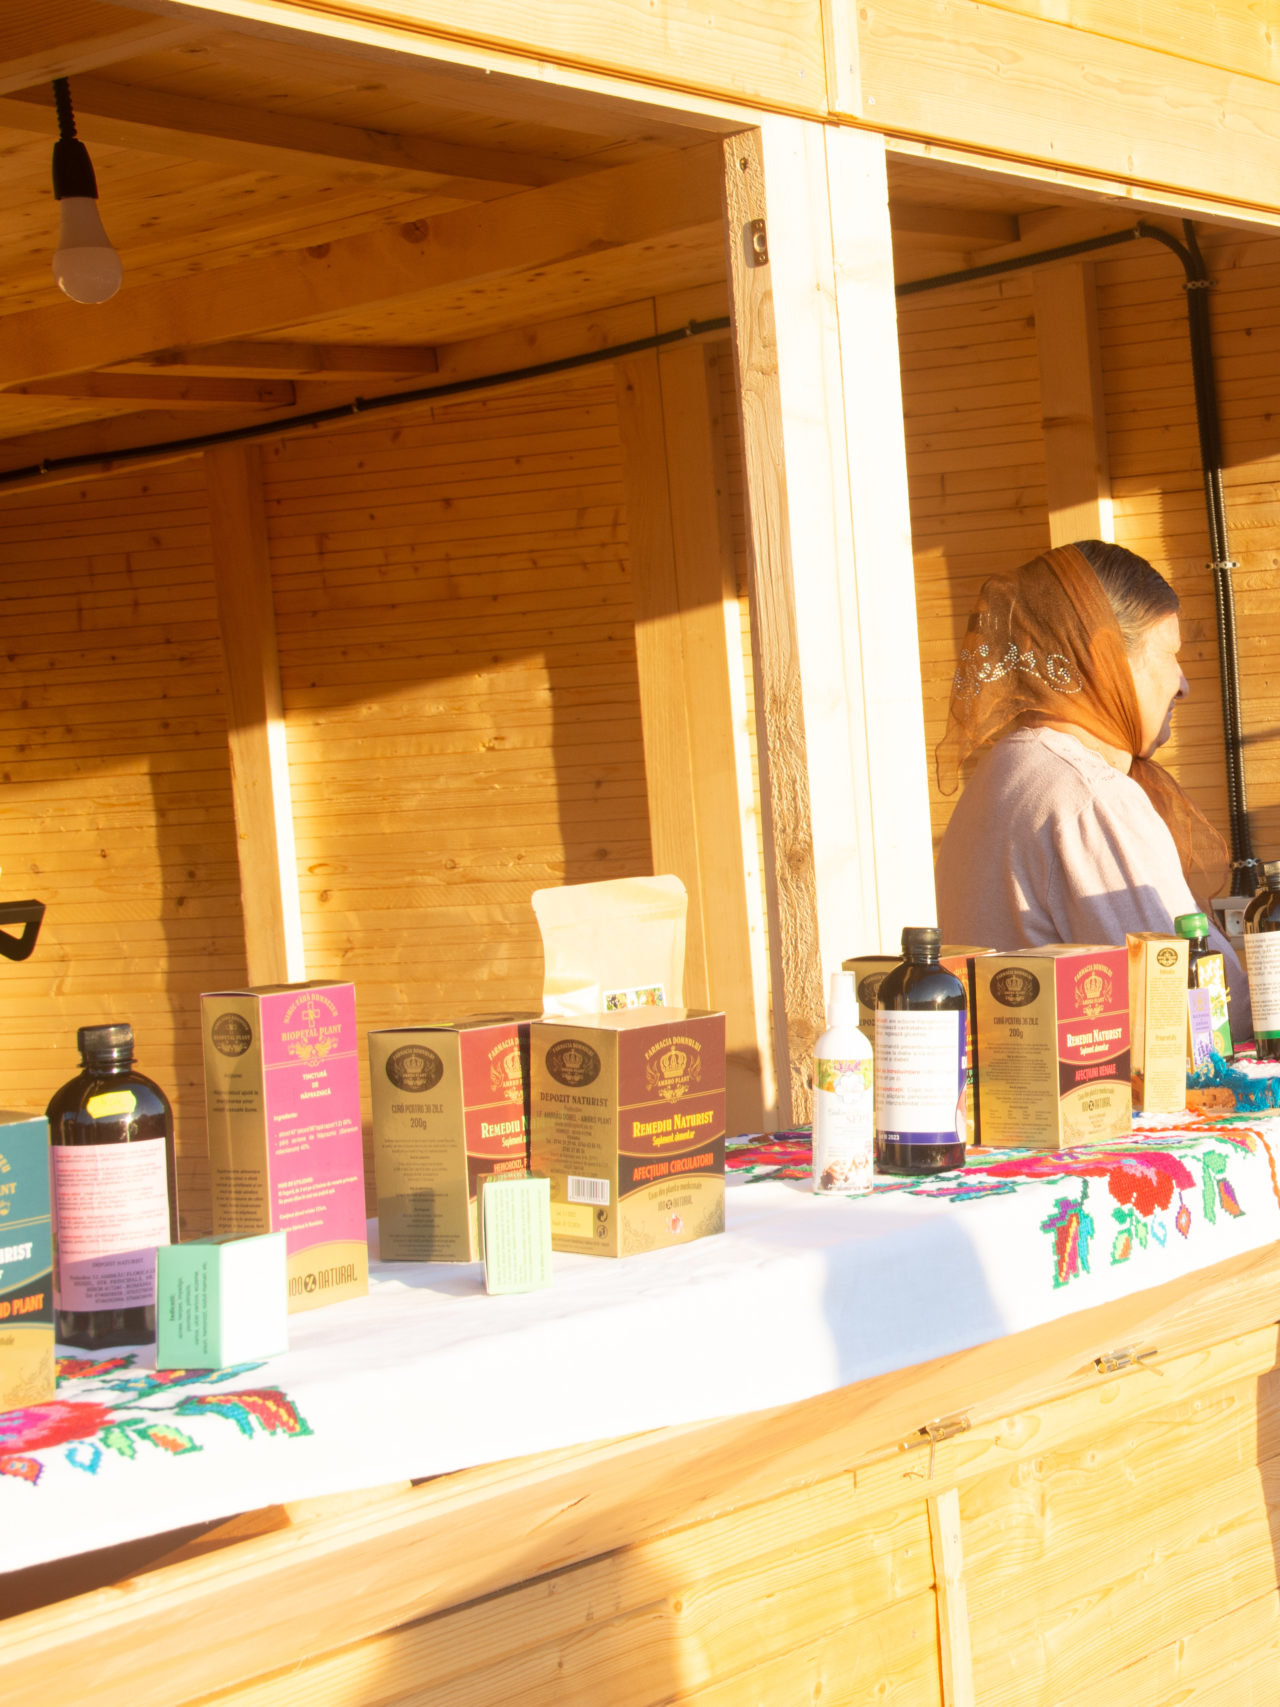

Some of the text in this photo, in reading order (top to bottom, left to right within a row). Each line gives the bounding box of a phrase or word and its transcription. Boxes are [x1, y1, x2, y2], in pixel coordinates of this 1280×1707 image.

[320, 1024, 342, 1036] PLANT
[1009, 1028, 1023, 1039] 200g
[1066, 1028, 1122, 1048] REMEDIU NATURIST
[540, 1092, 608, 1107] DEPOZIT NATURIST
[410, 1117, 427, 1130] 200g
[481, 1120, 520, 1138] REMEDIU
[632, 1110, 714, 1138] REMEDIU NATURIST
[633, 1152, 714, 1181] AFECȚIUNI CIRCULATORII
[0, 1242, 32, 1265] RIST
[318, 1264, 357, 1289] NATURAL
[12, 1294, 44, 1316] PLANT
